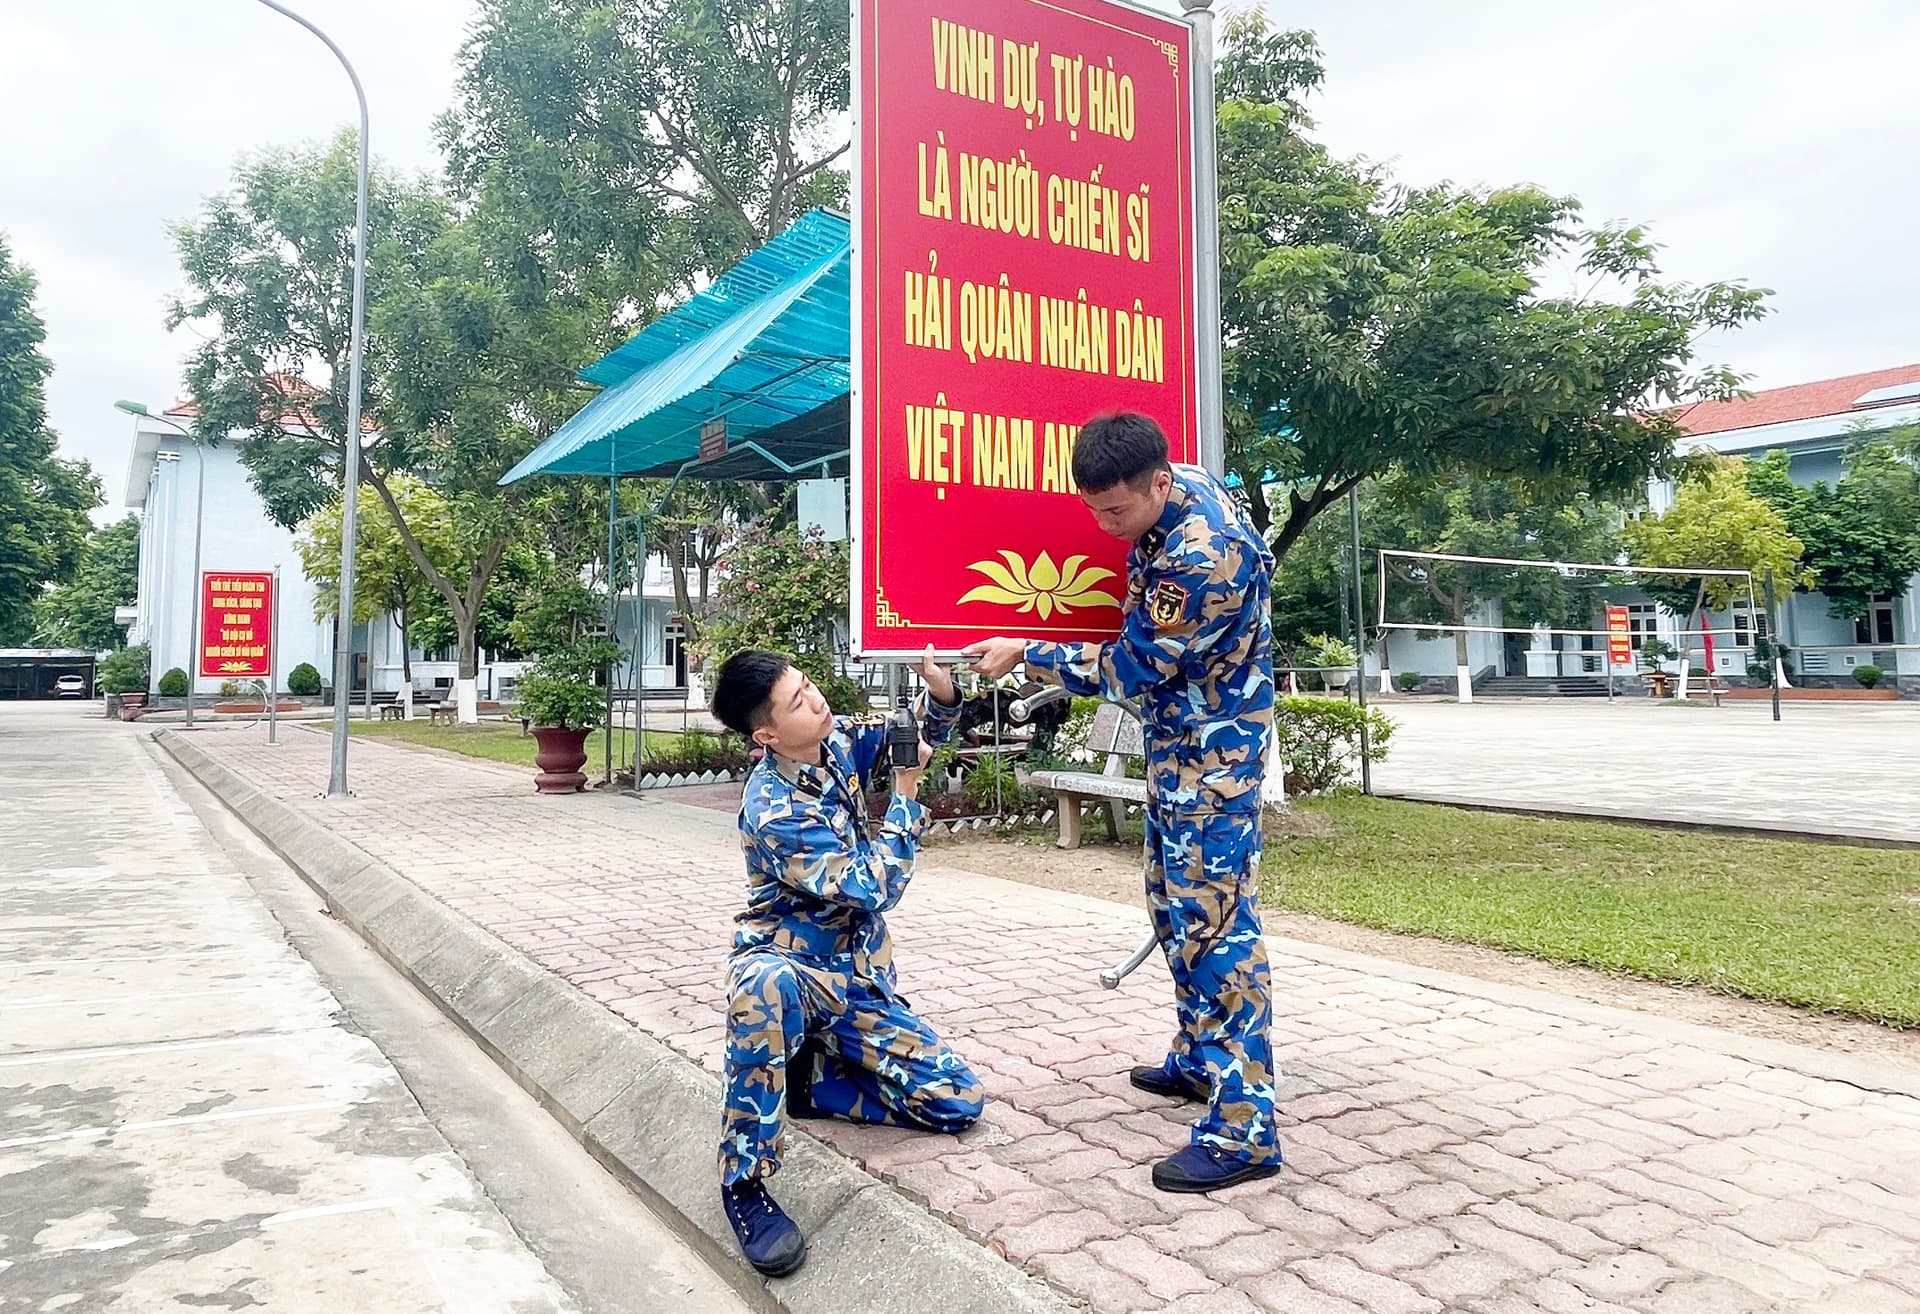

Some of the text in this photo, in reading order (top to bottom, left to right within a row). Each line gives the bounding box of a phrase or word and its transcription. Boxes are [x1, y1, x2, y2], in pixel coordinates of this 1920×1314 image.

[931, 17, 1135, 142] VINH DỰ, TỰ HÀO
[918, 130, 1150, 263] LÀ NGƯỜI CHIẾN SĨ
[904, 249, 1164, 383] HẢI QUÂN NHÂN DÂN
[905, 392, 1082, 500] VIỆT NAM AN
